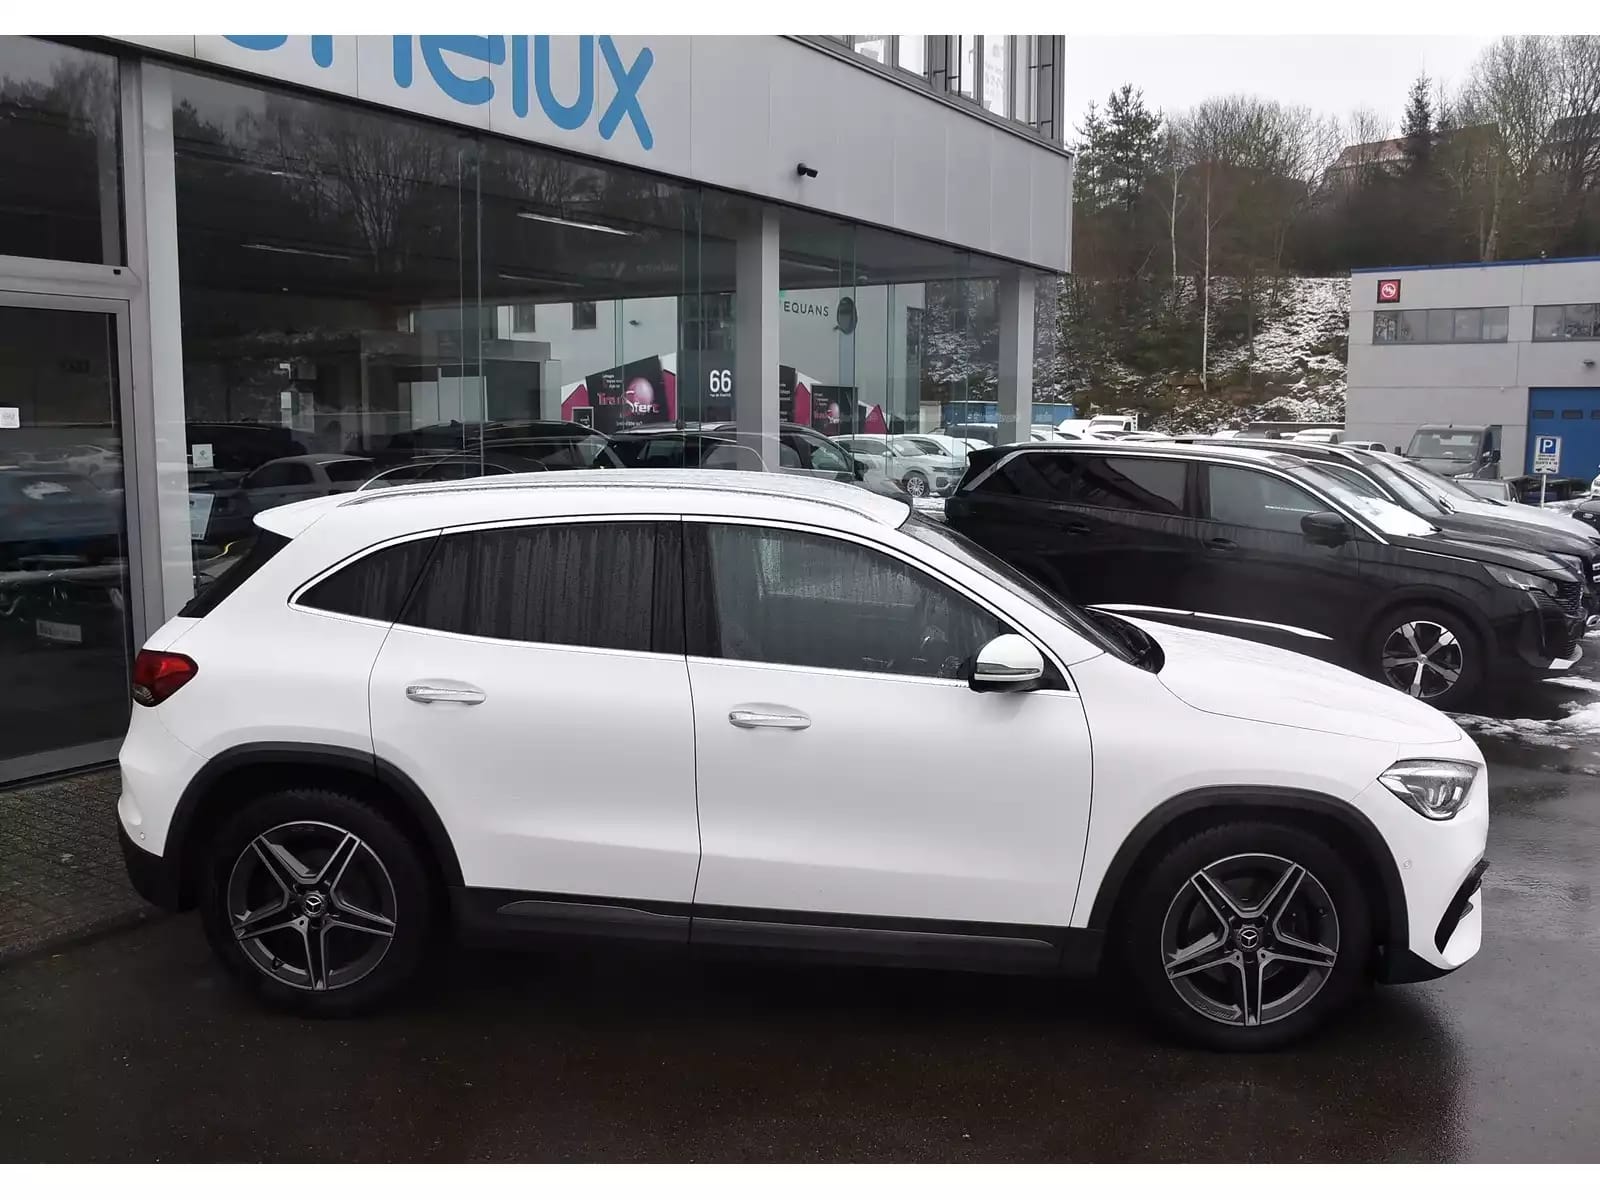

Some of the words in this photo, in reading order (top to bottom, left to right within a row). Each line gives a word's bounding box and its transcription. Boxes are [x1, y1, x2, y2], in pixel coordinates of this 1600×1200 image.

[783, 301, 829, 317] EQUANS
[709, 369, 732, 393] 66
[1542, 439, 1553, 453] P
